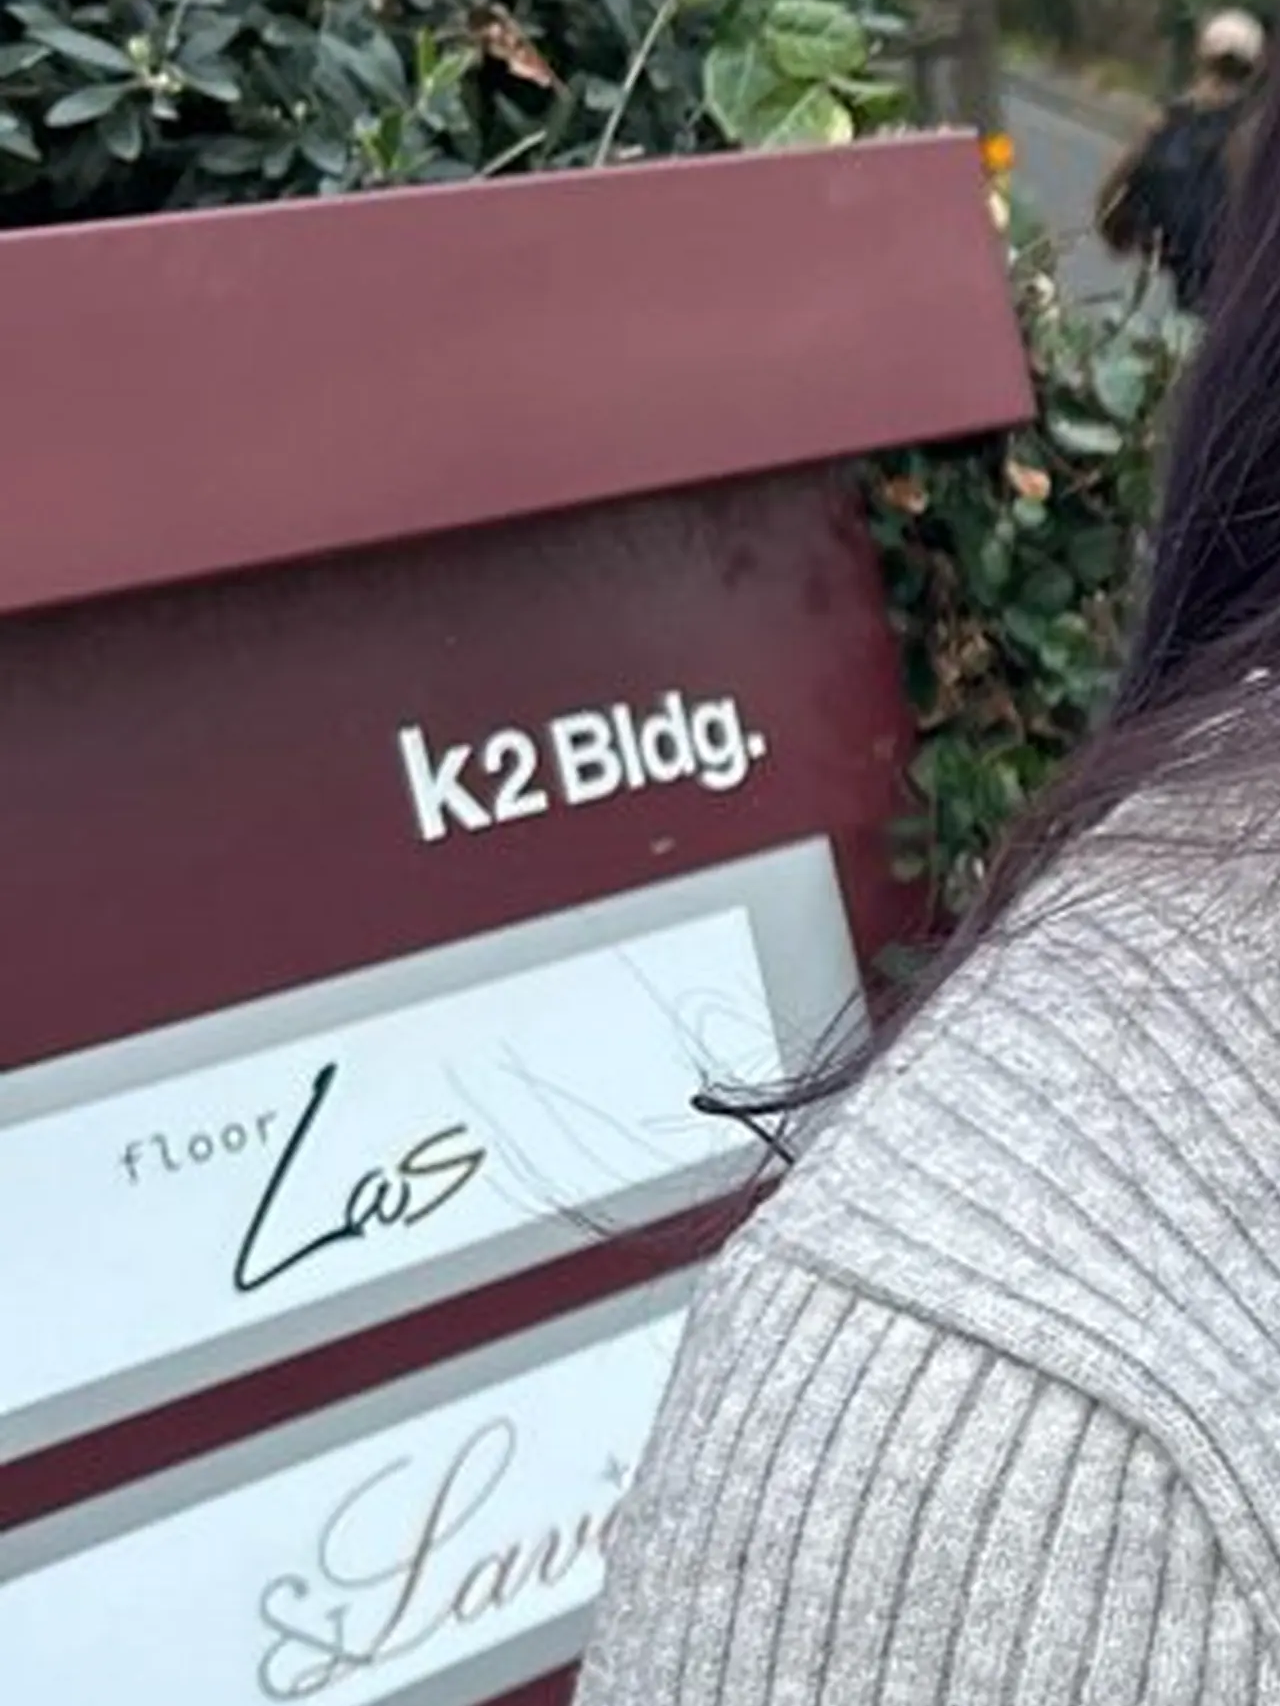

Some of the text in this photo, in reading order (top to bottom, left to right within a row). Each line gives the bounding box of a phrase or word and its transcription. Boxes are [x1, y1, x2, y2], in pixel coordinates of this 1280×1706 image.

[399, 691, 767, 841] k2 Bldg.
[120, 1109, 279, 1185] floor
